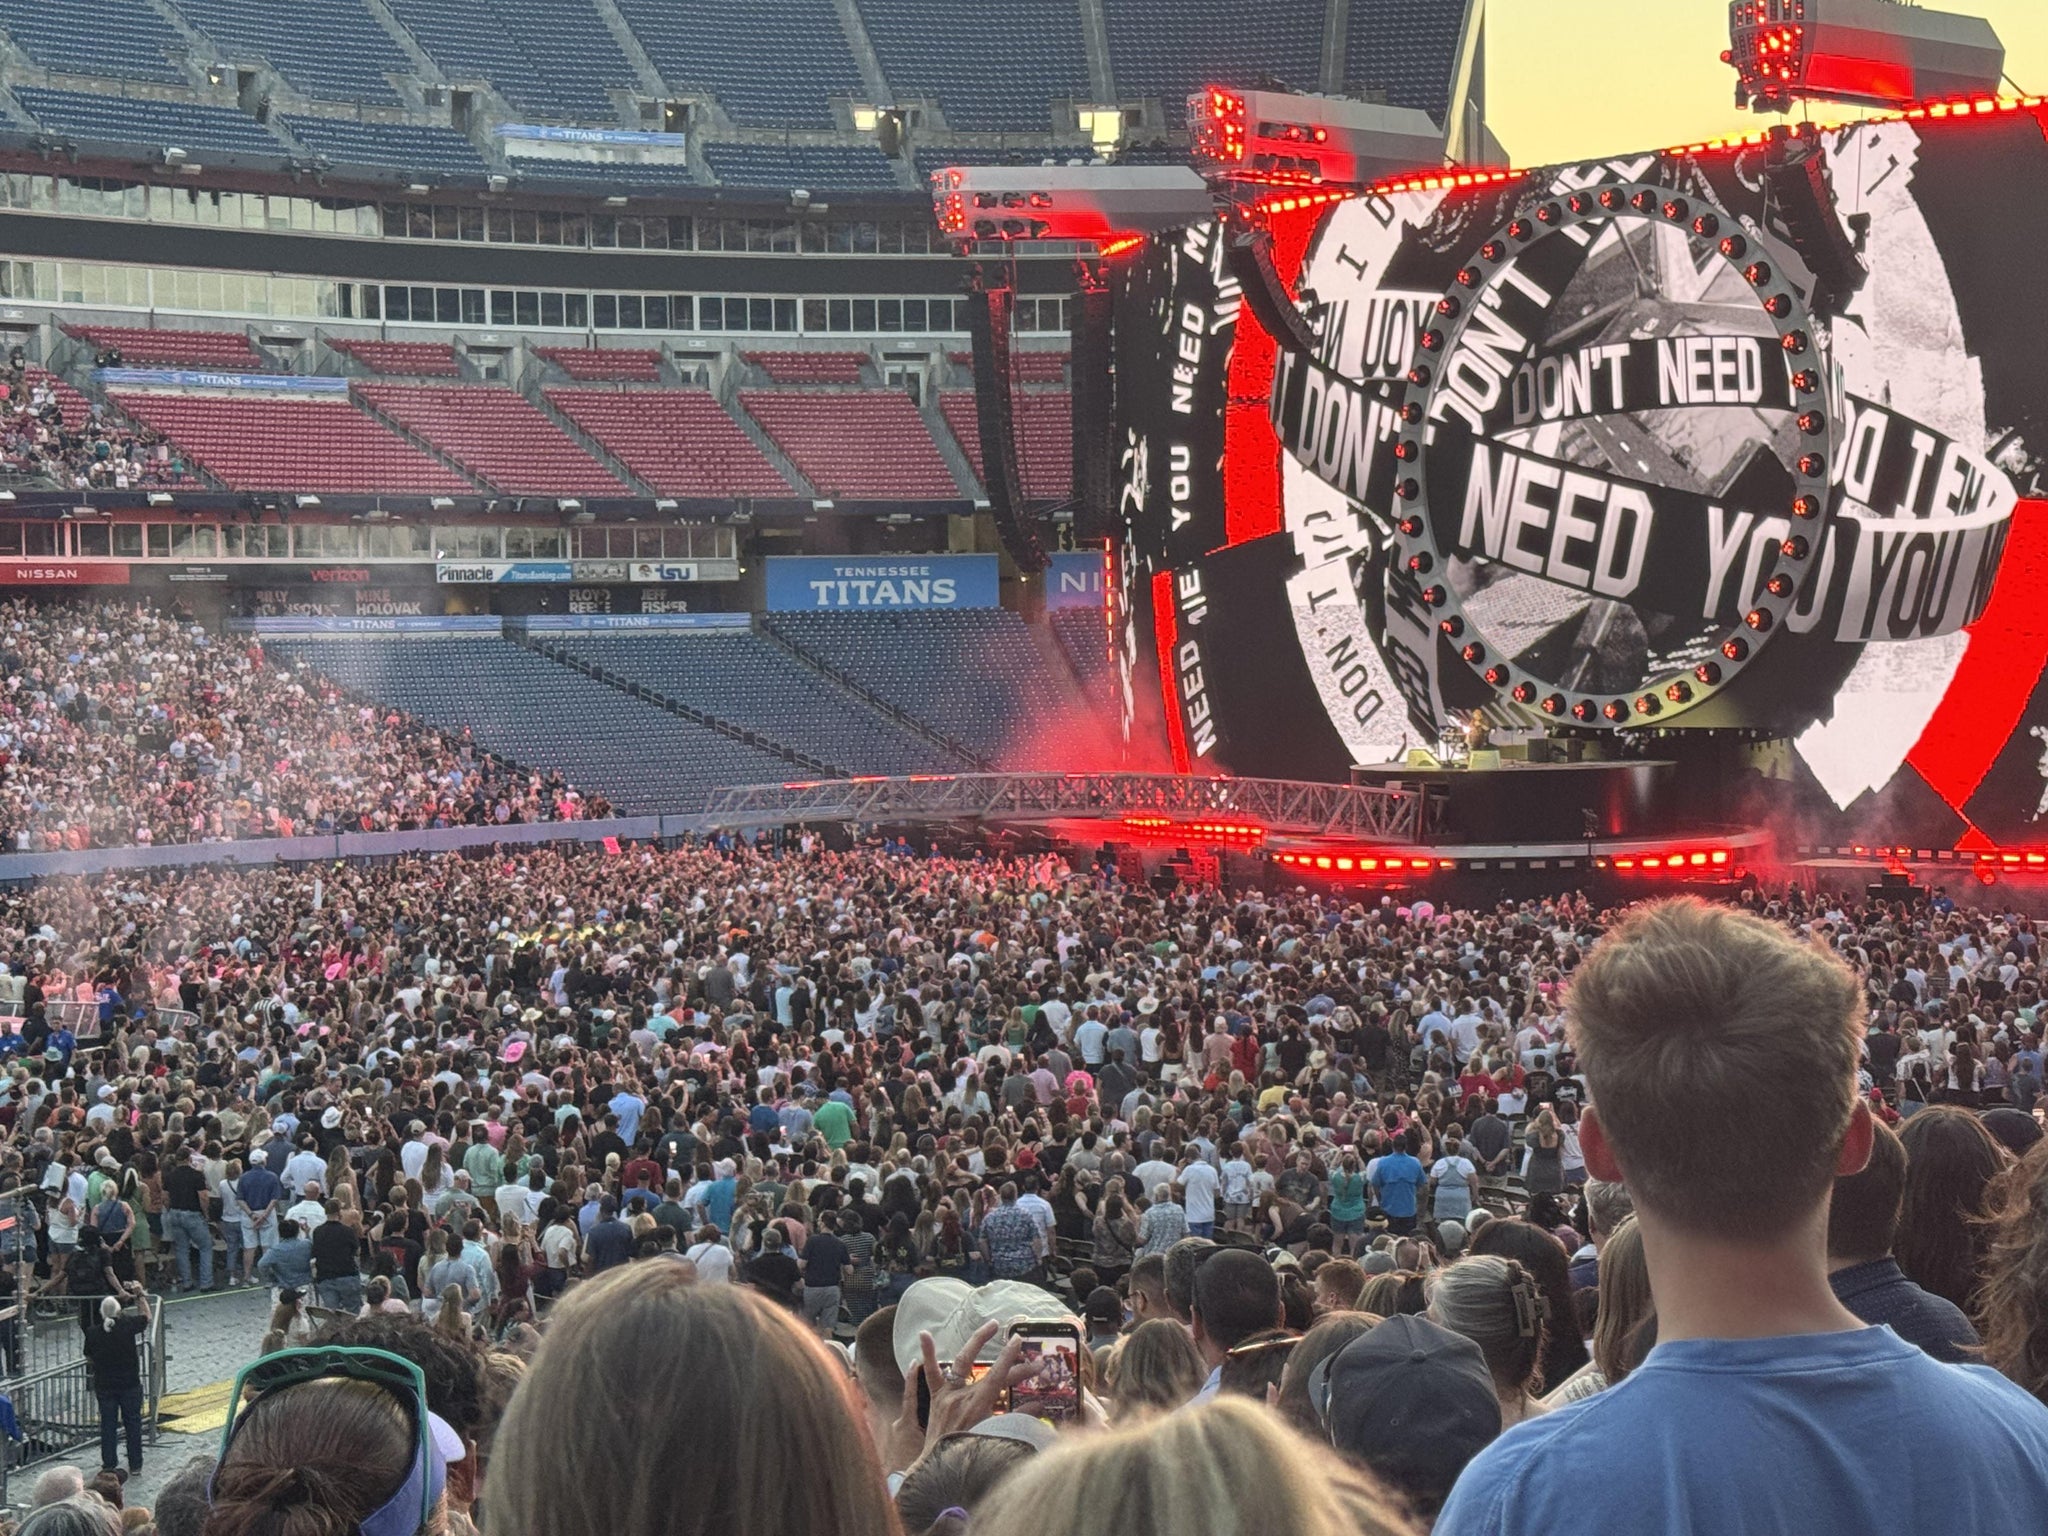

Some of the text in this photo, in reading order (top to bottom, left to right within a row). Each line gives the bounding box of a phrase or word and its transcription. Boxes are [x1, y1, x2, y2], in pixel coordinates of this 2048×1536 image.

[563, 130, 604, 141] TITANS
[1171, 303, 1205, 414] NEED
[198, 374, 241, 386] TITANS
[1513, 341, 1630, 425] DON'T
[1657, 336, 1763, 405] NEED
[1170, 446, 1191, 532] YOU
[1459, 442, 1654, 598] NEED
[17, 567, 79, 580] NISSAN
[310, 568, 371, 583] verizon
[439, 566, 494, 581] Pinnacle
[655, 564, 691, 580] tsu
[834, 566, 930, 577] TENNESSEE
[355, 589, 390, 602] MIKE
[810, 578, 957, 606] TITANS
[355, 602, 422, 616] HOLOVAK
[352, 619, 396, 629] TITANS
[606, 617, 650, 627] TITANS
[1179, 640, 1217, 757] NEED
